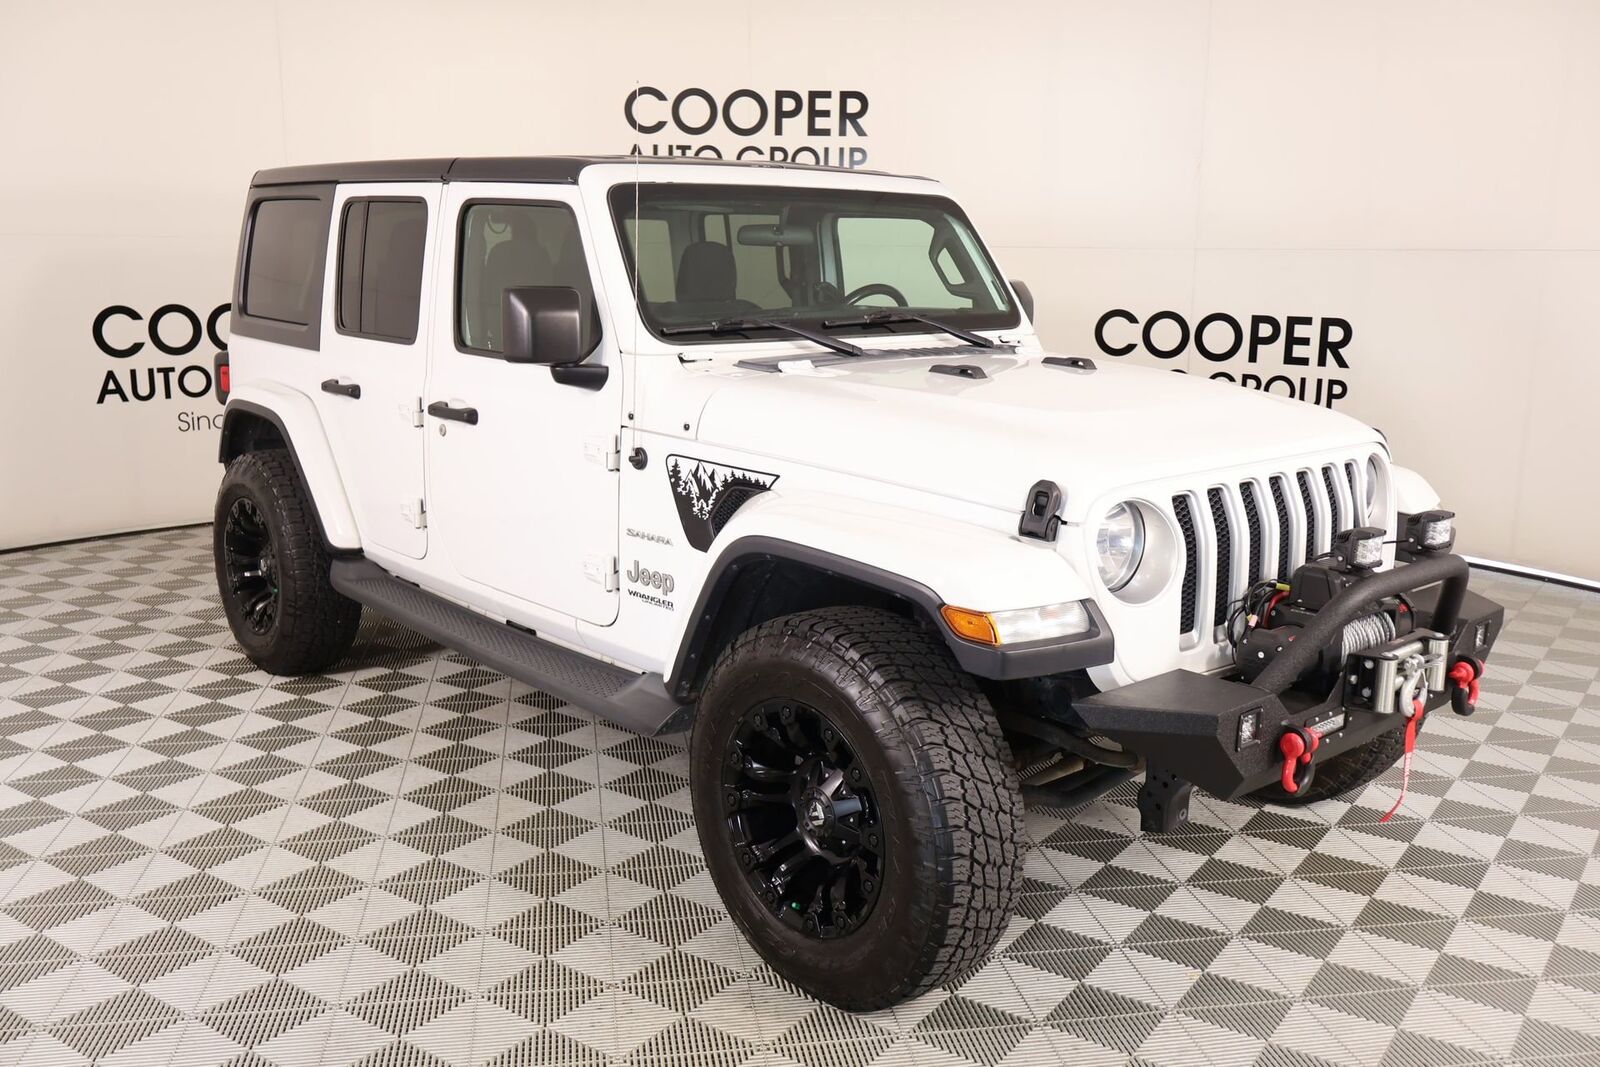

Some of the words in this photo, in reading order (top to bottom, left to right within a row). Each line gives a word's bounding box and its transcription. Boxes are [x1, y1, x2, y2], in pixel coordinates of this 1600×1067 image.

[624, 86, 869, 136] COOPER
[1094, 308, 1353, 369] COOPER
[96, 365, 212, 404] AUTO
[626, 528, 674, 546] SAHARA
[627, 560, 674, 595] Jeep
[627, 588, 674, 608] WRANGLER
